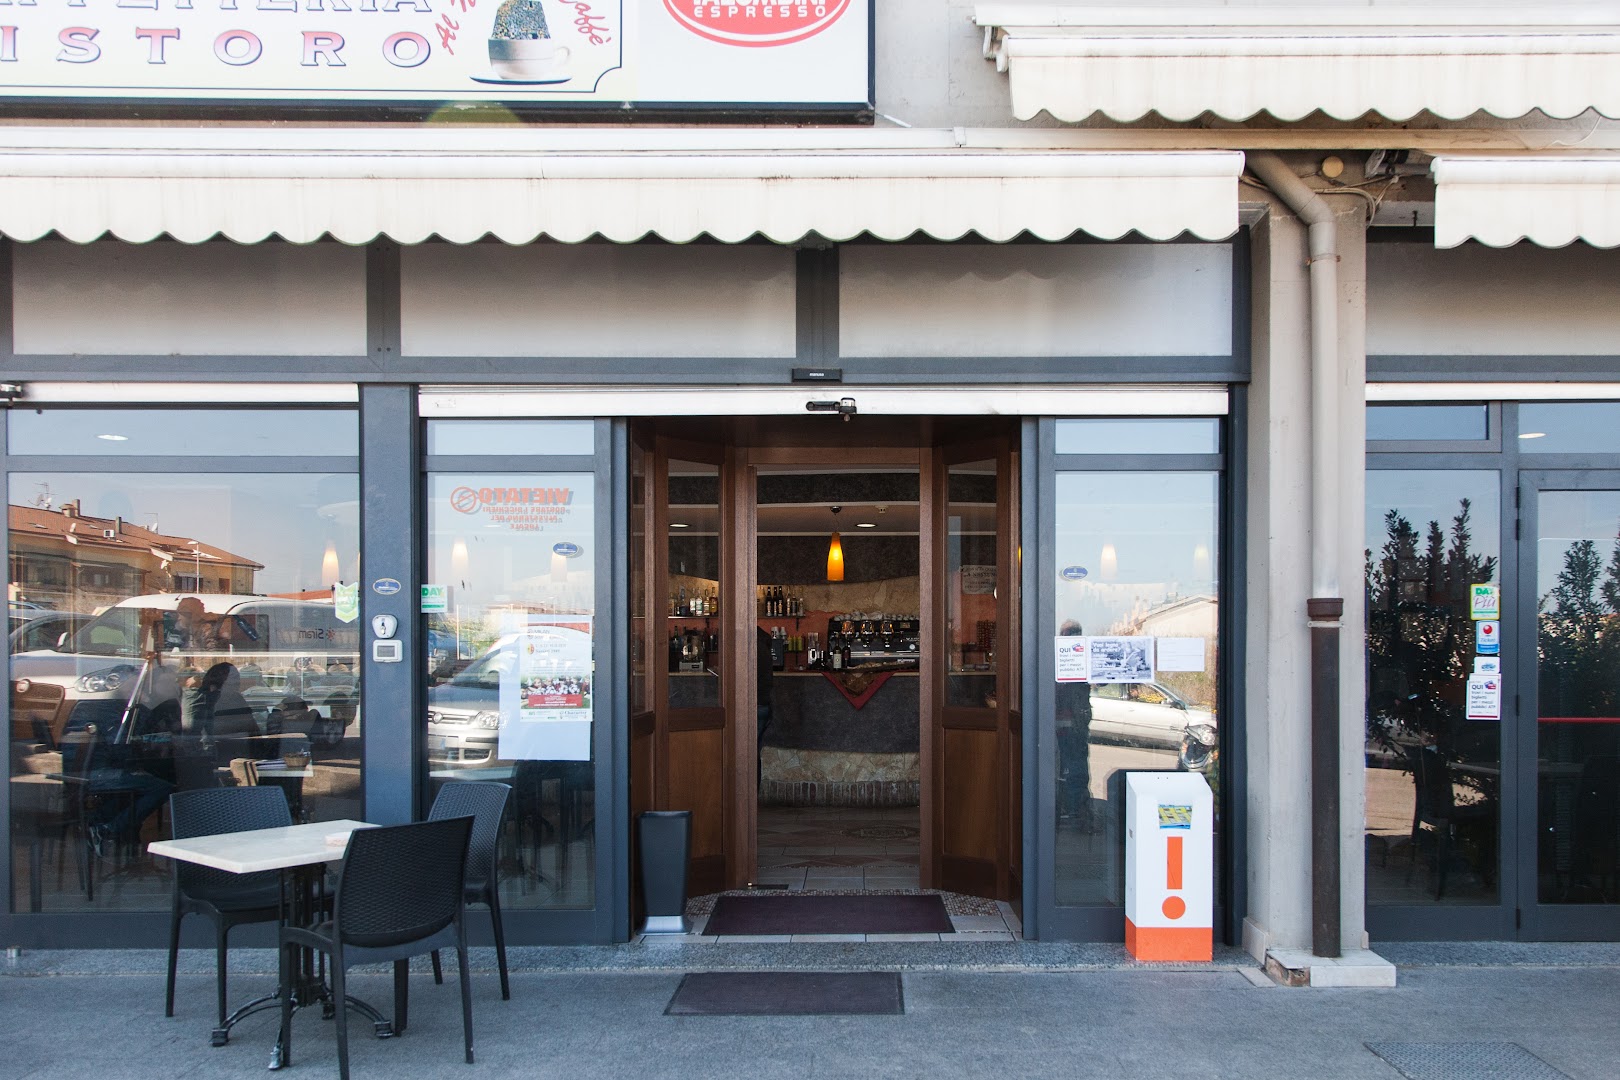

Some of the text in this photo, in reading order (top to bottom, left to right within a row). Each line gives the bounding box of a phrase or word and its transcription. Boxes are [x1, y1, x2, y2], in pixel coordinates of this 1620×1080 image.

[558, 0, 611, 46] affè
[693, 5, 826, 18] ESPRESSO
[0, 26, 431, 68] ISTORO
[421, 587, 444, 596] DAY
